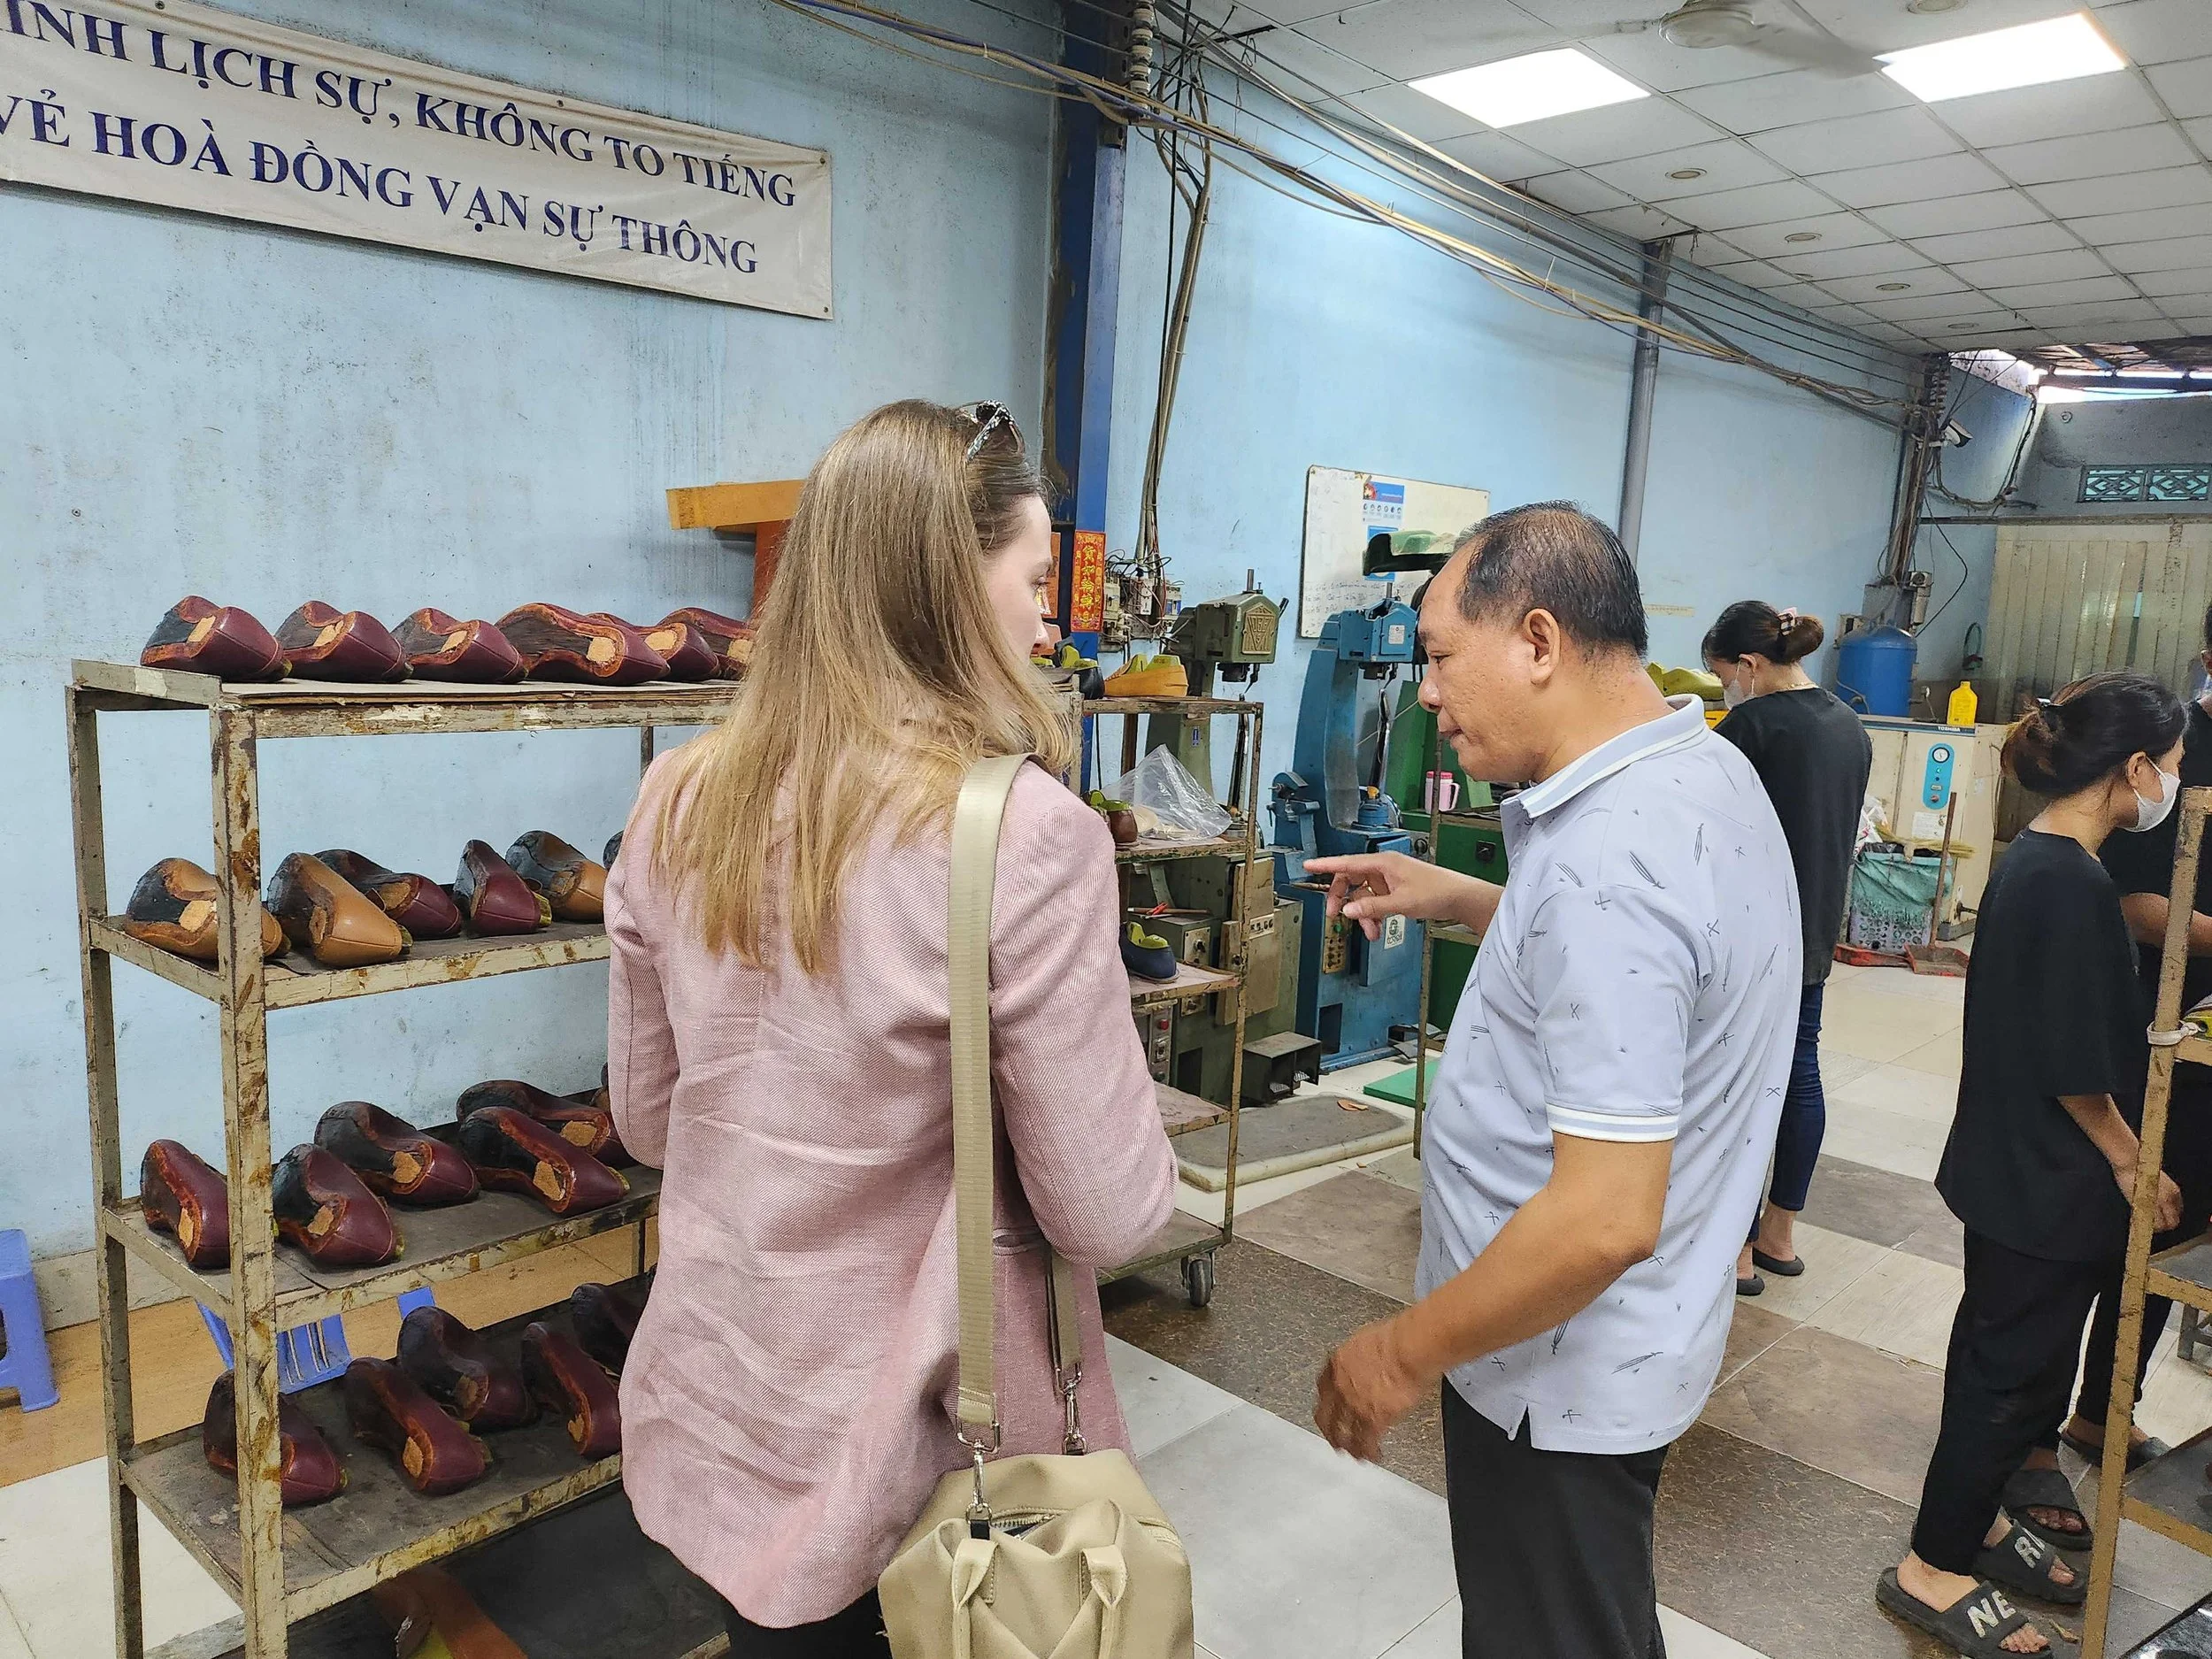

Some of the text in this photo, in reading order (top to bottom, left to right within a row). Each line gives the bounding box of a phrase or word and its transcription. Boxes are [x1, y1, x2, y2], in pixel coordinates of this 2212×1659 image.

[0, 0, 796, 207] INH LỊCH SỰ, KHÔNG TO TIẾNG
[0, 88, 758, 273] VẺ HOÀ ĐỒNG VẠN SỰ THÔNG
[1967, 1590, 2016, 1638] NE
